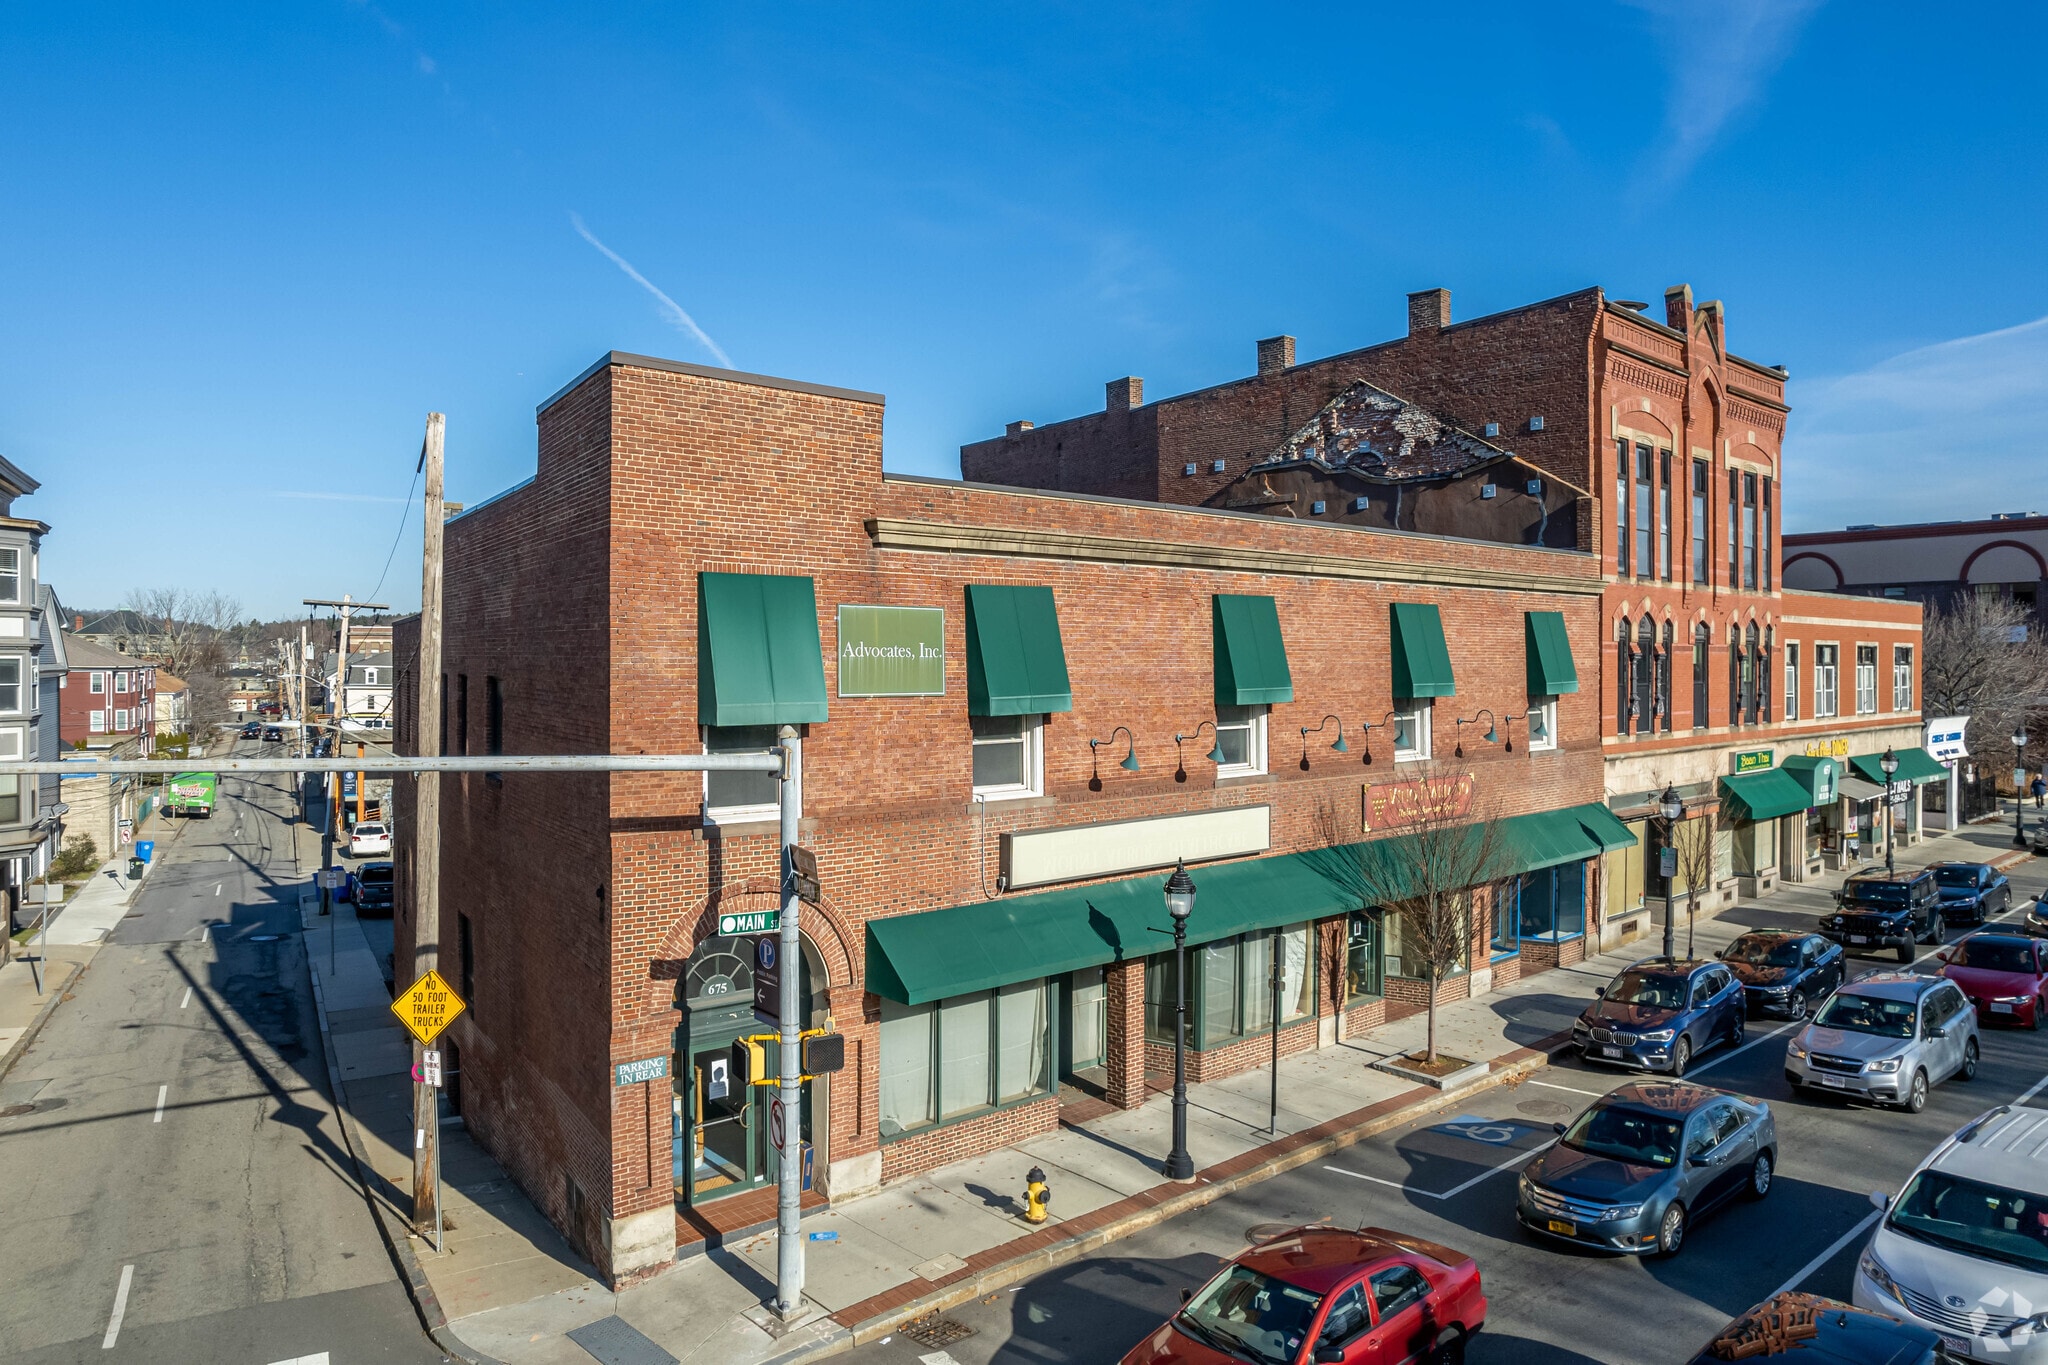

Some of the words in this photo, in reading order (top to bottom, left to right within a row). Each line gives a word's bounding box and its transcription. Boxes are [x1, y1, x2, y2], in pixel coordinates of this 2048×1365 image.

[842, 641, 915, 661] Advocates,
[919, 643, 942, 658] Inc.
[130, 861, 135, 869] 5
[737, 914, 765, 931] MAIN
[425, 980, 436, 990] NO
[708, 983, 727, 994] 675
[413, 992, 423, 1002] 50
[428, 992, 447, 1002] FOOT
[413, 1004, 446, 1014] TRAILER
[413, 1016, 444, 1027] TRUCKS
[619, 1057, 663, 1075] PARKING
[620, 1074, 633, 1085] IN
[635, 1067, 663, 1081] REAR
